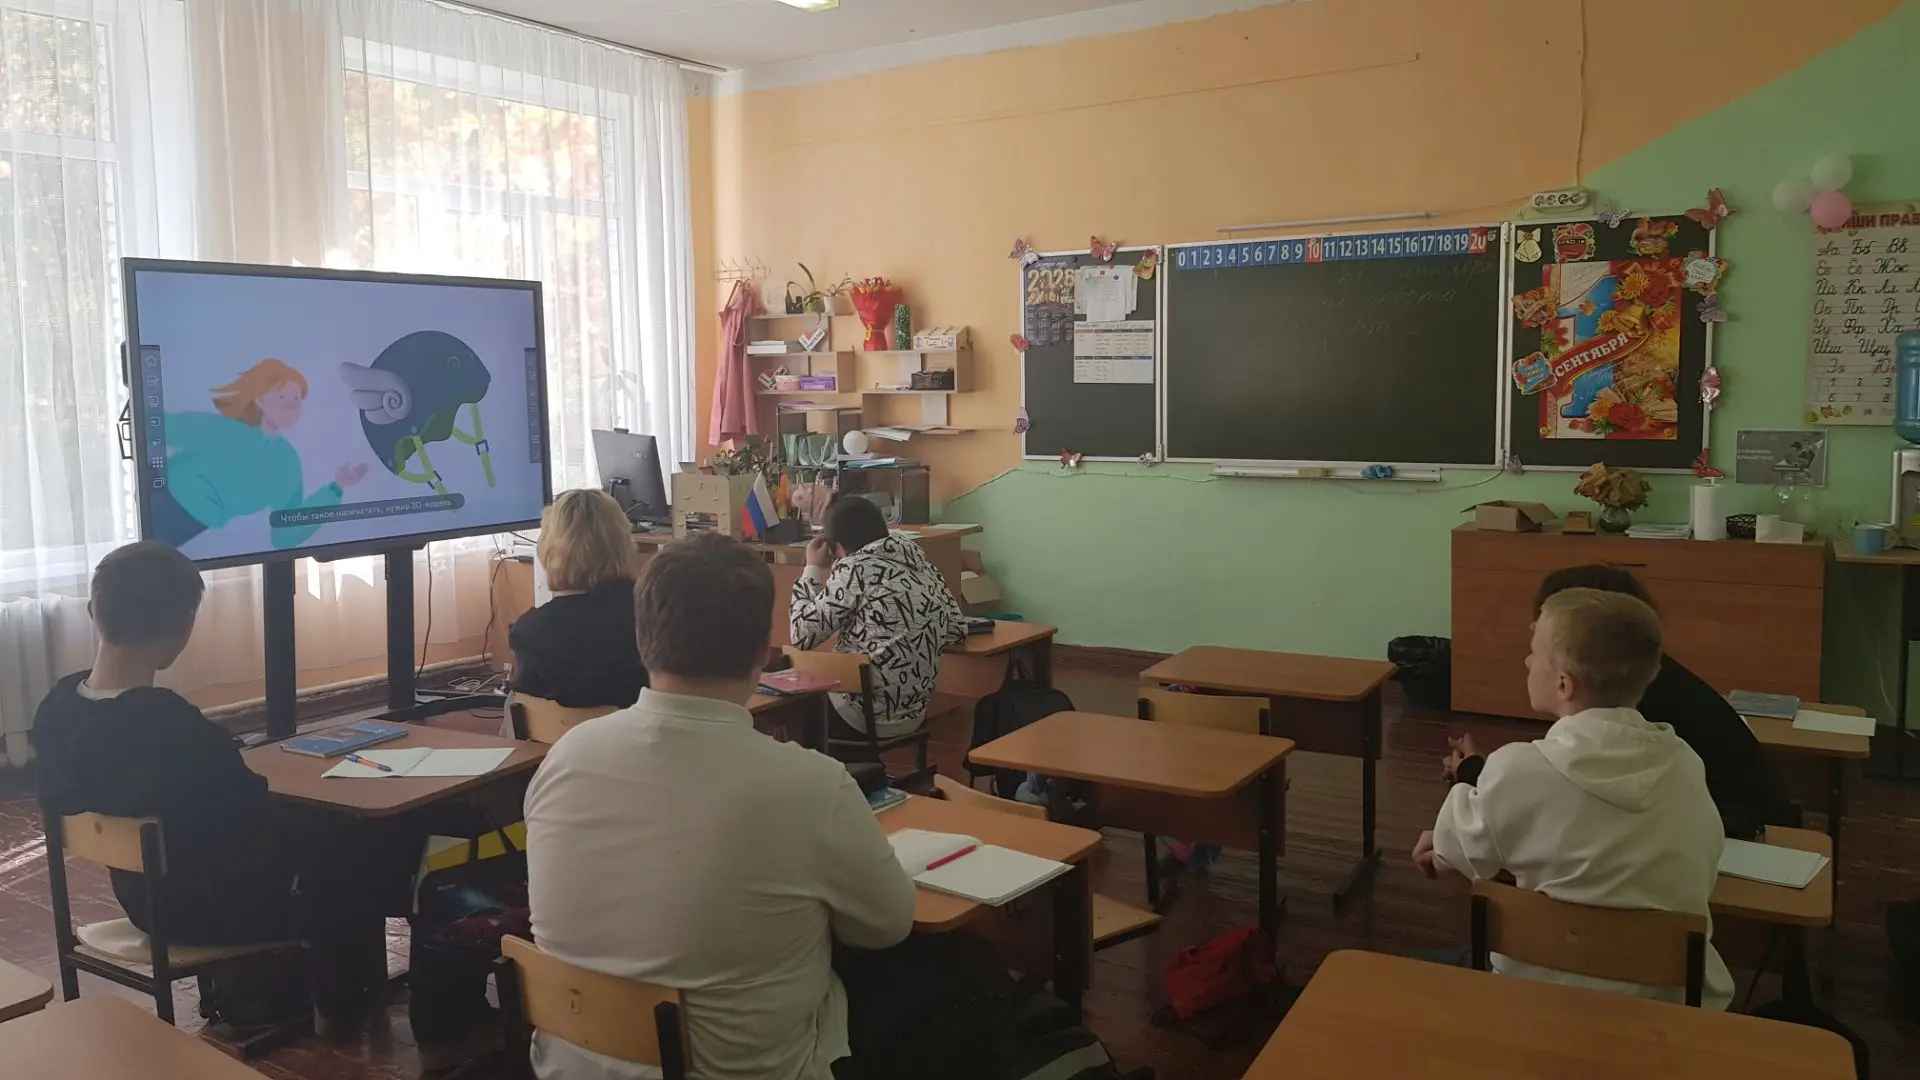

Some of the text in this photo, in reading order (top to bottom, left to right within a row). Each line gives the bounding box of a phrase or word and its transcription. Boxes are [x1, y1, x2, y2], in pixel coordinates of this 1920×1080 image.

[1178, 232, 1486, 267] 0 1 2 3 4 5 6 7 8 9 10 11 12 13 14 15 16 17 18 19 20
[1554, 331, 1629, 377] СЕНТЯБРЯ
[280, 511, 309, 523] Чтобы
[311, 510, 336, 521] такое
